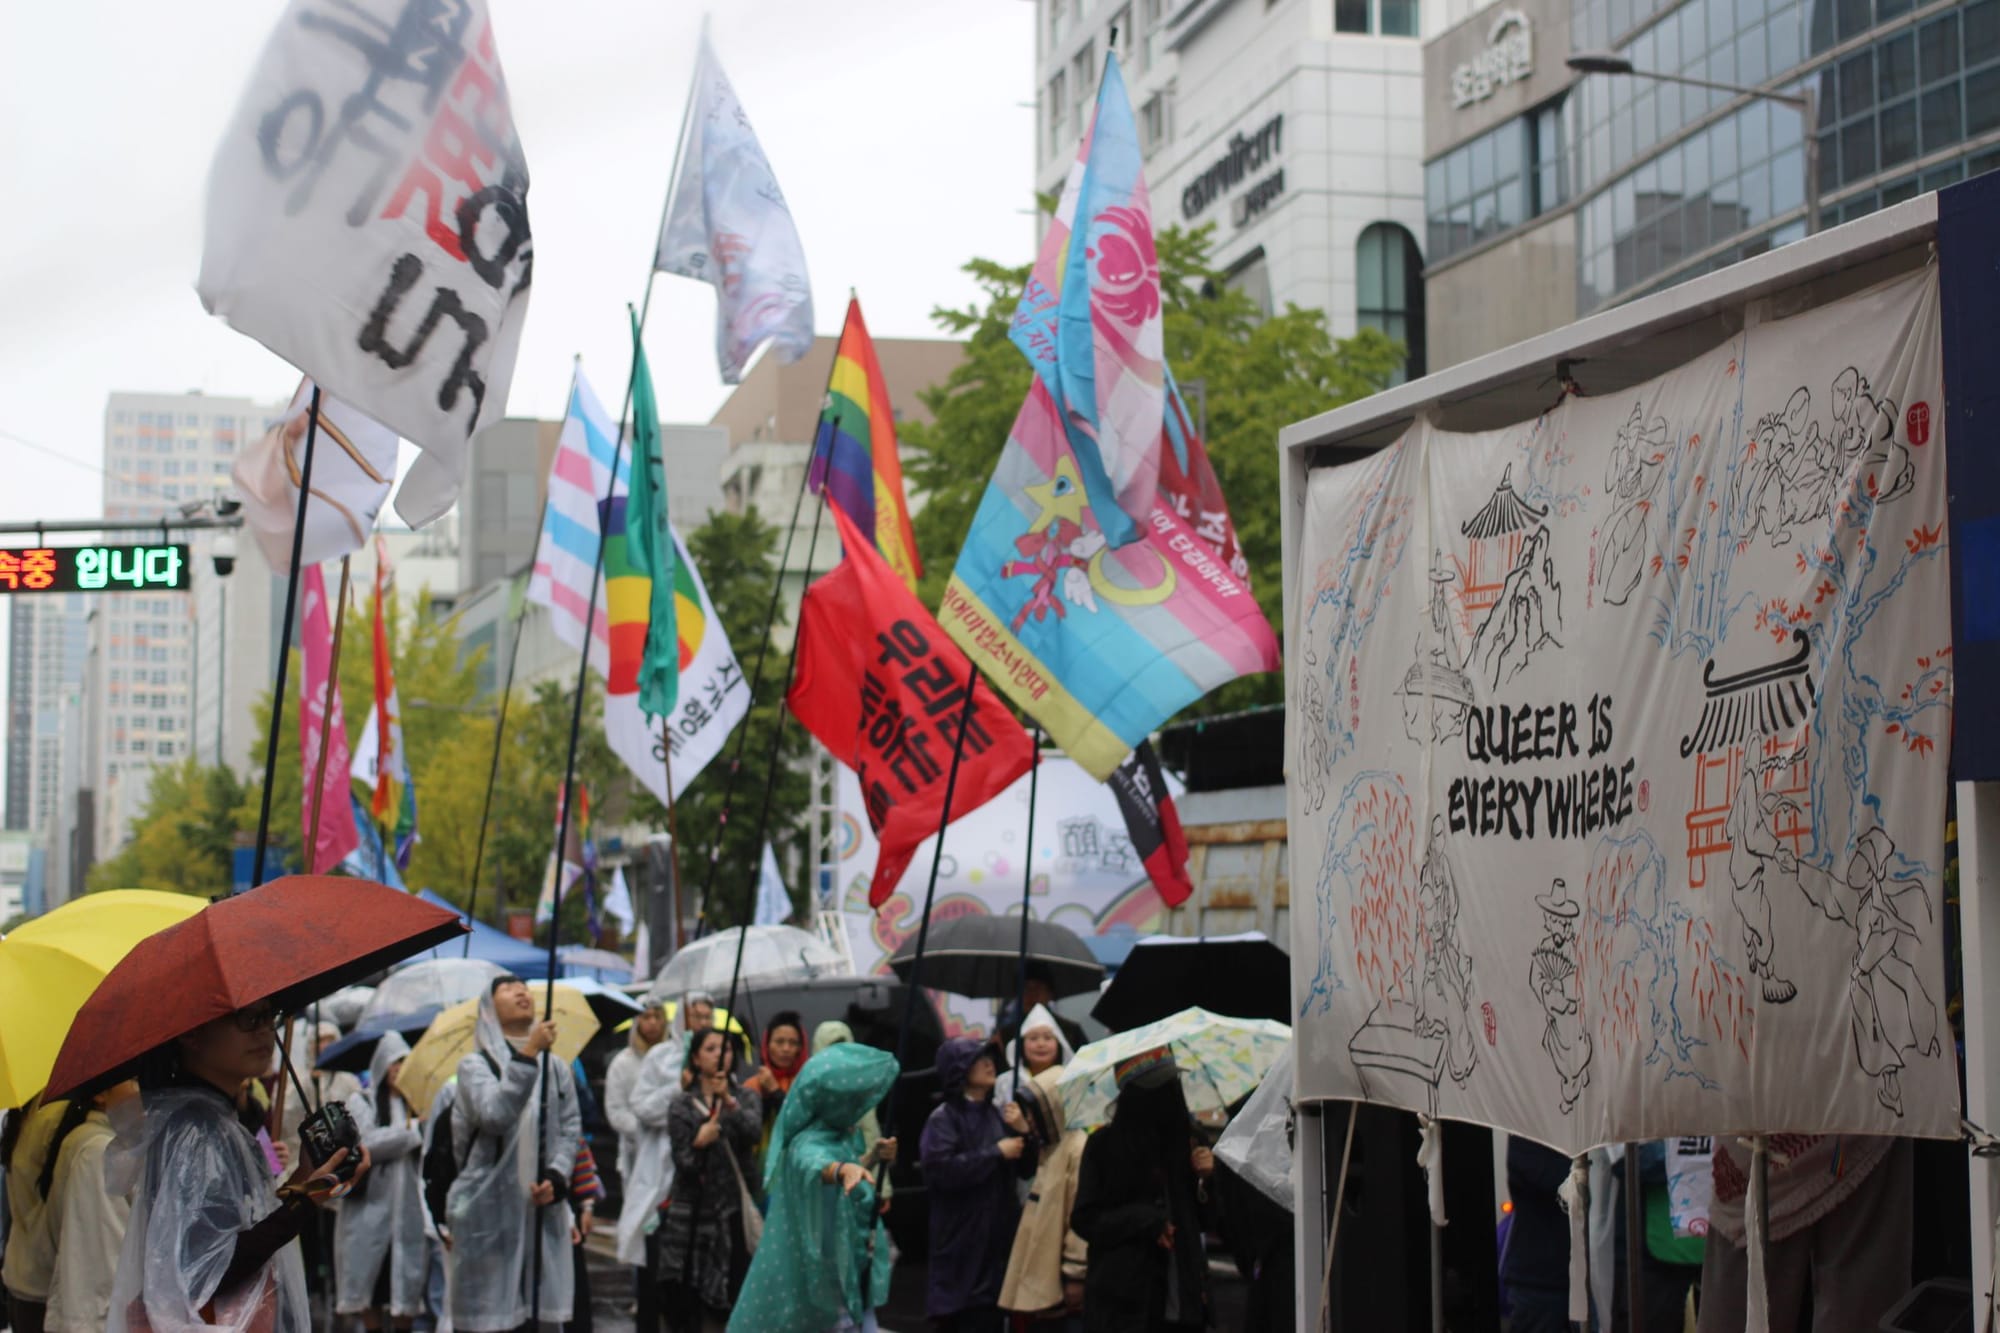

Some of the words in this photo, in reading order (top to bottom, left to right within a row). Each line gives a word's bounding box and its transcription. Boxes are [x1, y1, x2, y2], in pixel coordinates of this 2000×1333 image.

[76, 547, 182, 588] 입니다
[877, 620, 993, 761] 우리는
[1466, 702, 1580, 765] QUEER
[1587, 692, 1612, 759] IS
[1448, 757, 1635, 840] EVERYWHERE
